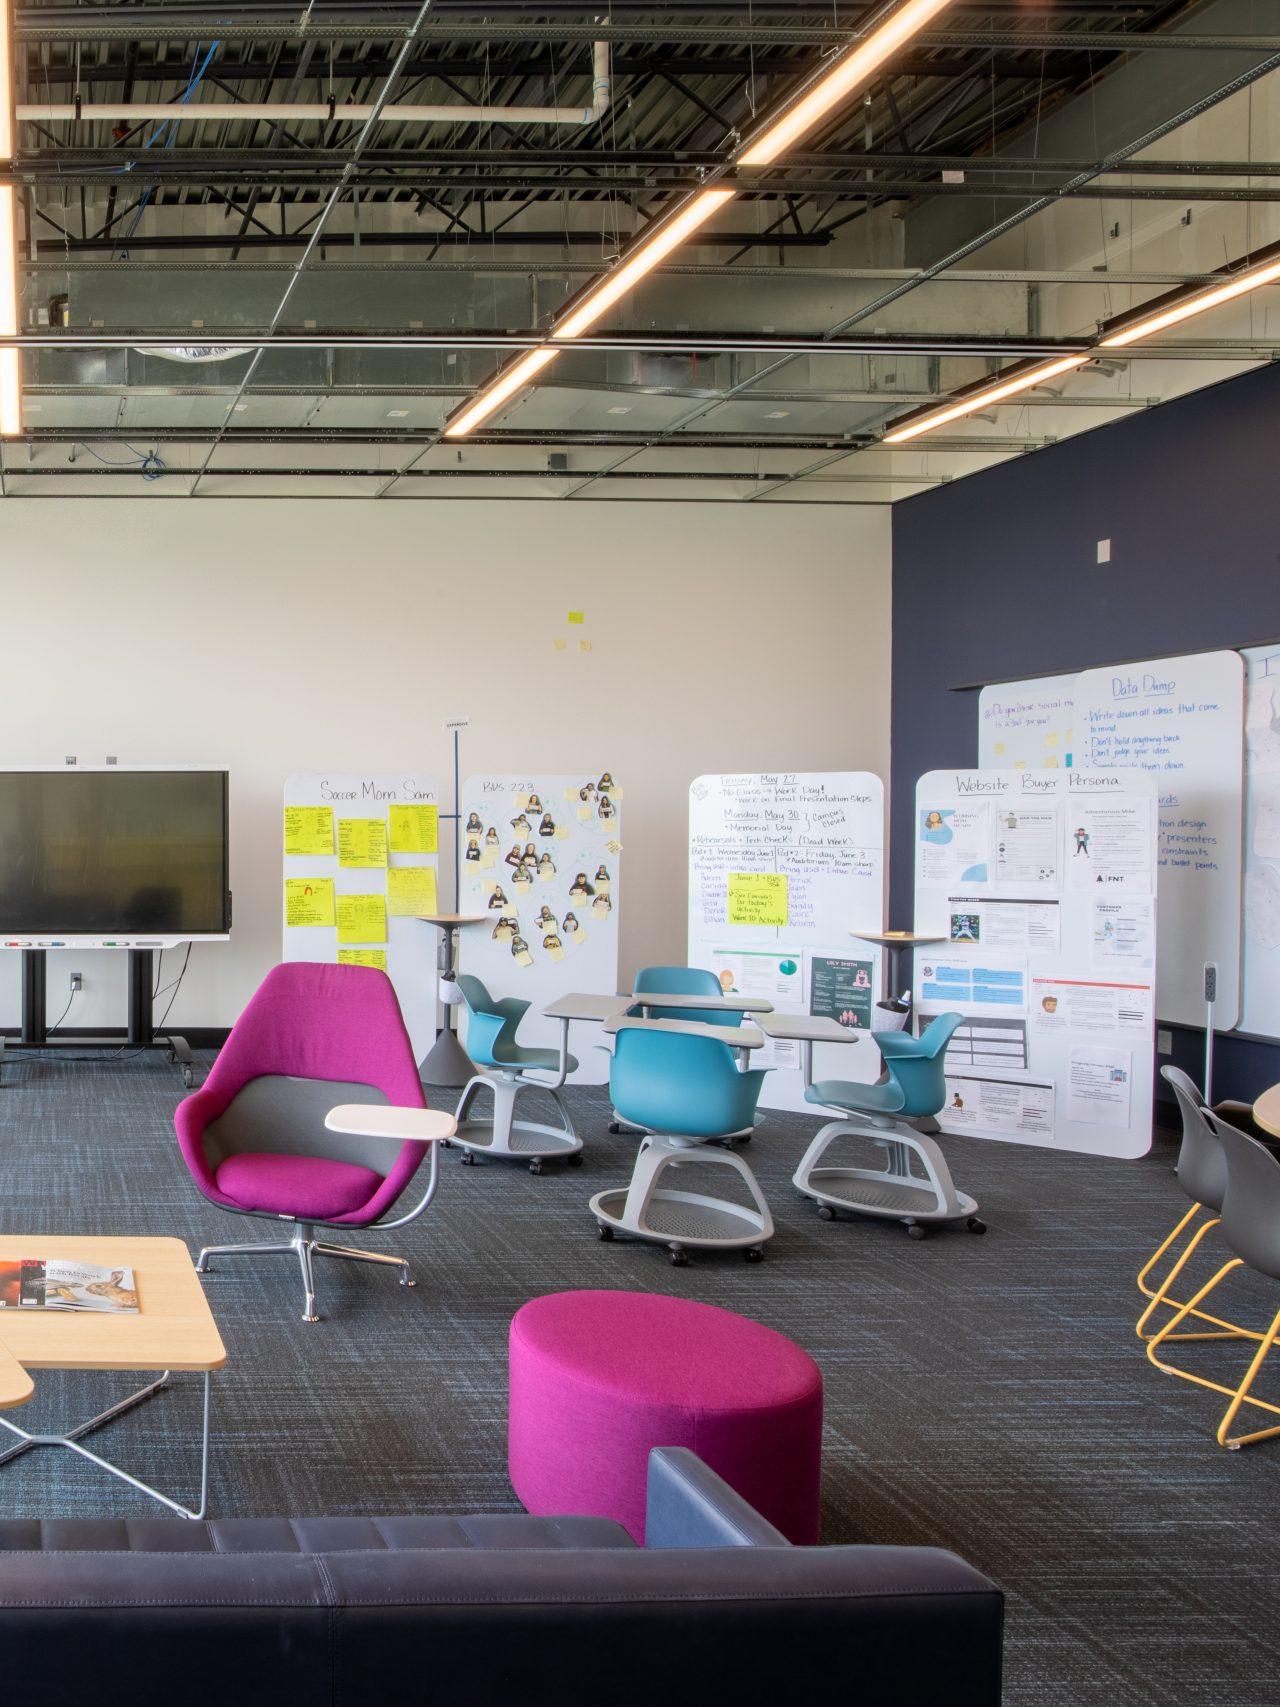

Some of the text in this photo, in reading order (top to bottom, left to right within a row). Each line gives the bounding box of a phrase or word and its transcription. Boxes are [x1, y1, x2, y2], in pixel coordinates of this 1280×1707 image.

[1112, 674, 1176, 697] Data Dump
[1089, 709, 1115, 723] Write
[1116, 710, 1138, 719] down
[1152, 706, 1173, 716] ideas
[1178, 703, 1195, 714] that
[1198, 703, 1220, 711] come
[1098, 724, 1116, 733] mind
[1091, 737, 1111, 748] Don't
[1114, 736, 1130, 746] hold
[1163, 760, 1184, 771] down
[760, 774, 798, 785] May 27
[956, 773, 1121, 793] Website Buyer Persona
[320, 779, 434, 801] Soccer Mom Sam
[482, 782, 534, 793] BUS 223
[774, 785, 798, 796] Work
[802, 784, 826, 796] Day!
[774, 795, 797, 806] Final
[799, 795, 849, 805] Presentation
[763, 809, 785, 824] May
[787, 809, 800, 819] 30
[730, 823, 793, 834] Memorial Day
[1178, 818, 1207, 832] design
[1166, 833, 1218, 845] presenters
[1161, 847, 1209, 857] constraints
